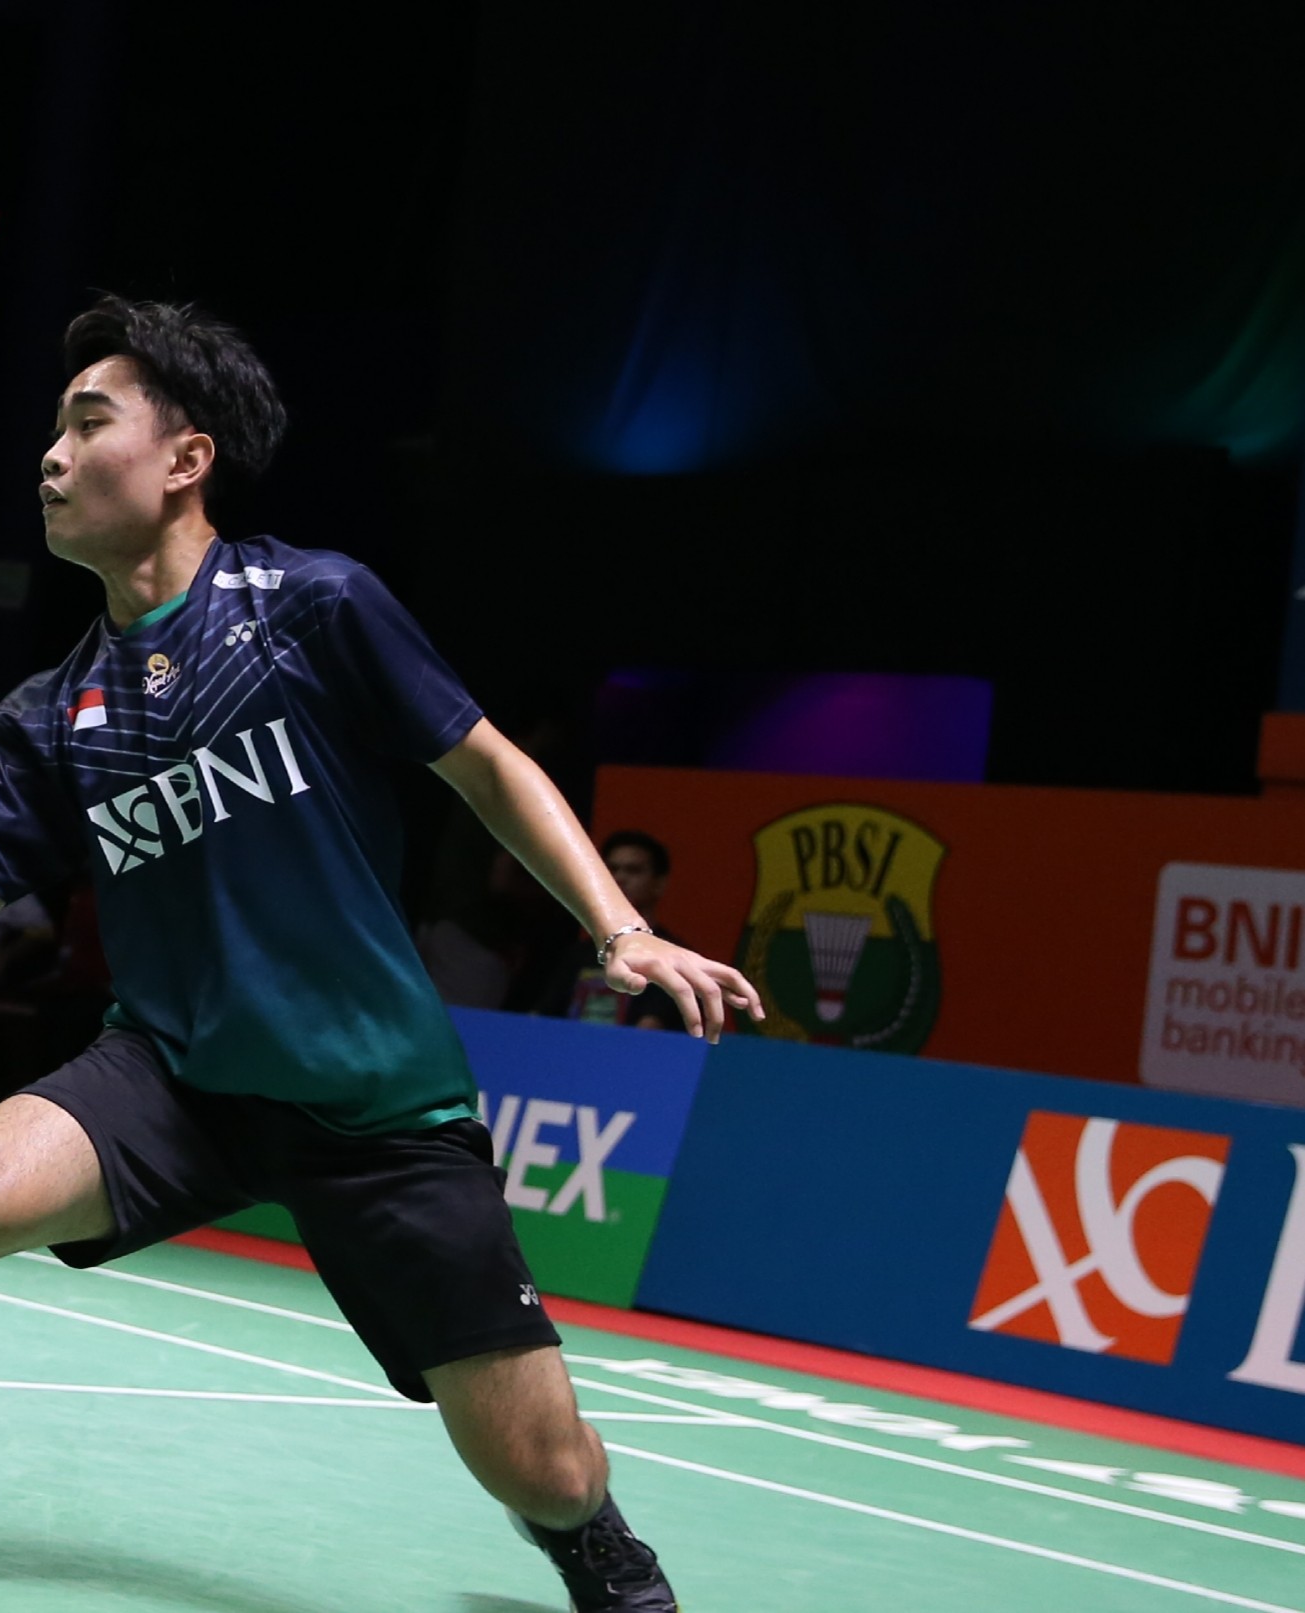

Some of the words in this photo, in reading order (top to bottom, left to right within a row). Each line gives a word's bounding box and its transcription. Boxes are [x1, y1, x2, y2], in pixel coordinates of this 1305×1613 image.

[150, 717, 311, 845] BNI
[789, 819, 902, 897] PBSI
[1173, 895, 1303, 971] BNI
[1165, 973, 1305, 1021] mobile
